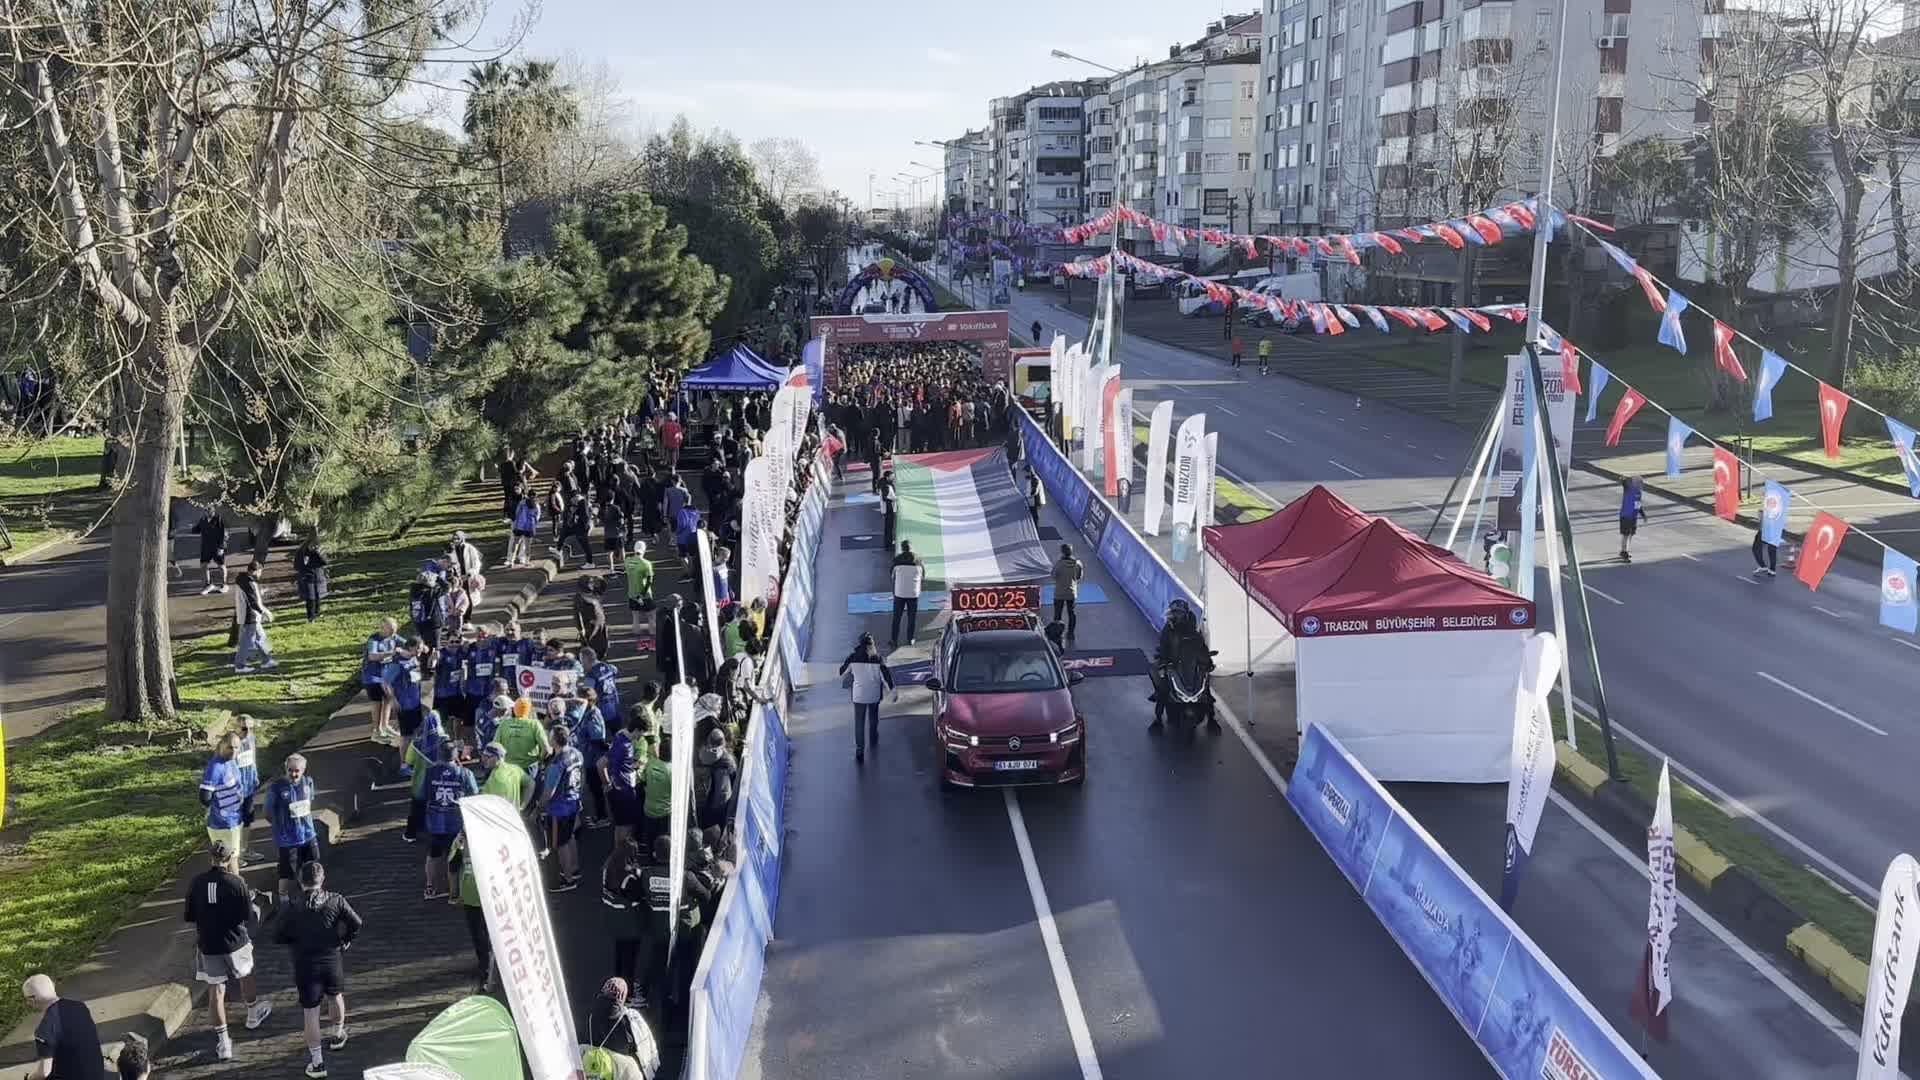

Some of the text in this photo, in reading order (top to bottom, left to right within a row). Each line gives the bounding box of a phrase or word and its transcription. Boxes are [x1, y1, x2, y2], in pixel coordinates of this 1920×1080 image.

[1177, 455, 1192, 504] TRABZON
[958, 591, 1027, 609] 0:00:25
[1324, 613, 1497, 633] TRABZON BÜYÜKŞEHİR BELEDİYESİ
